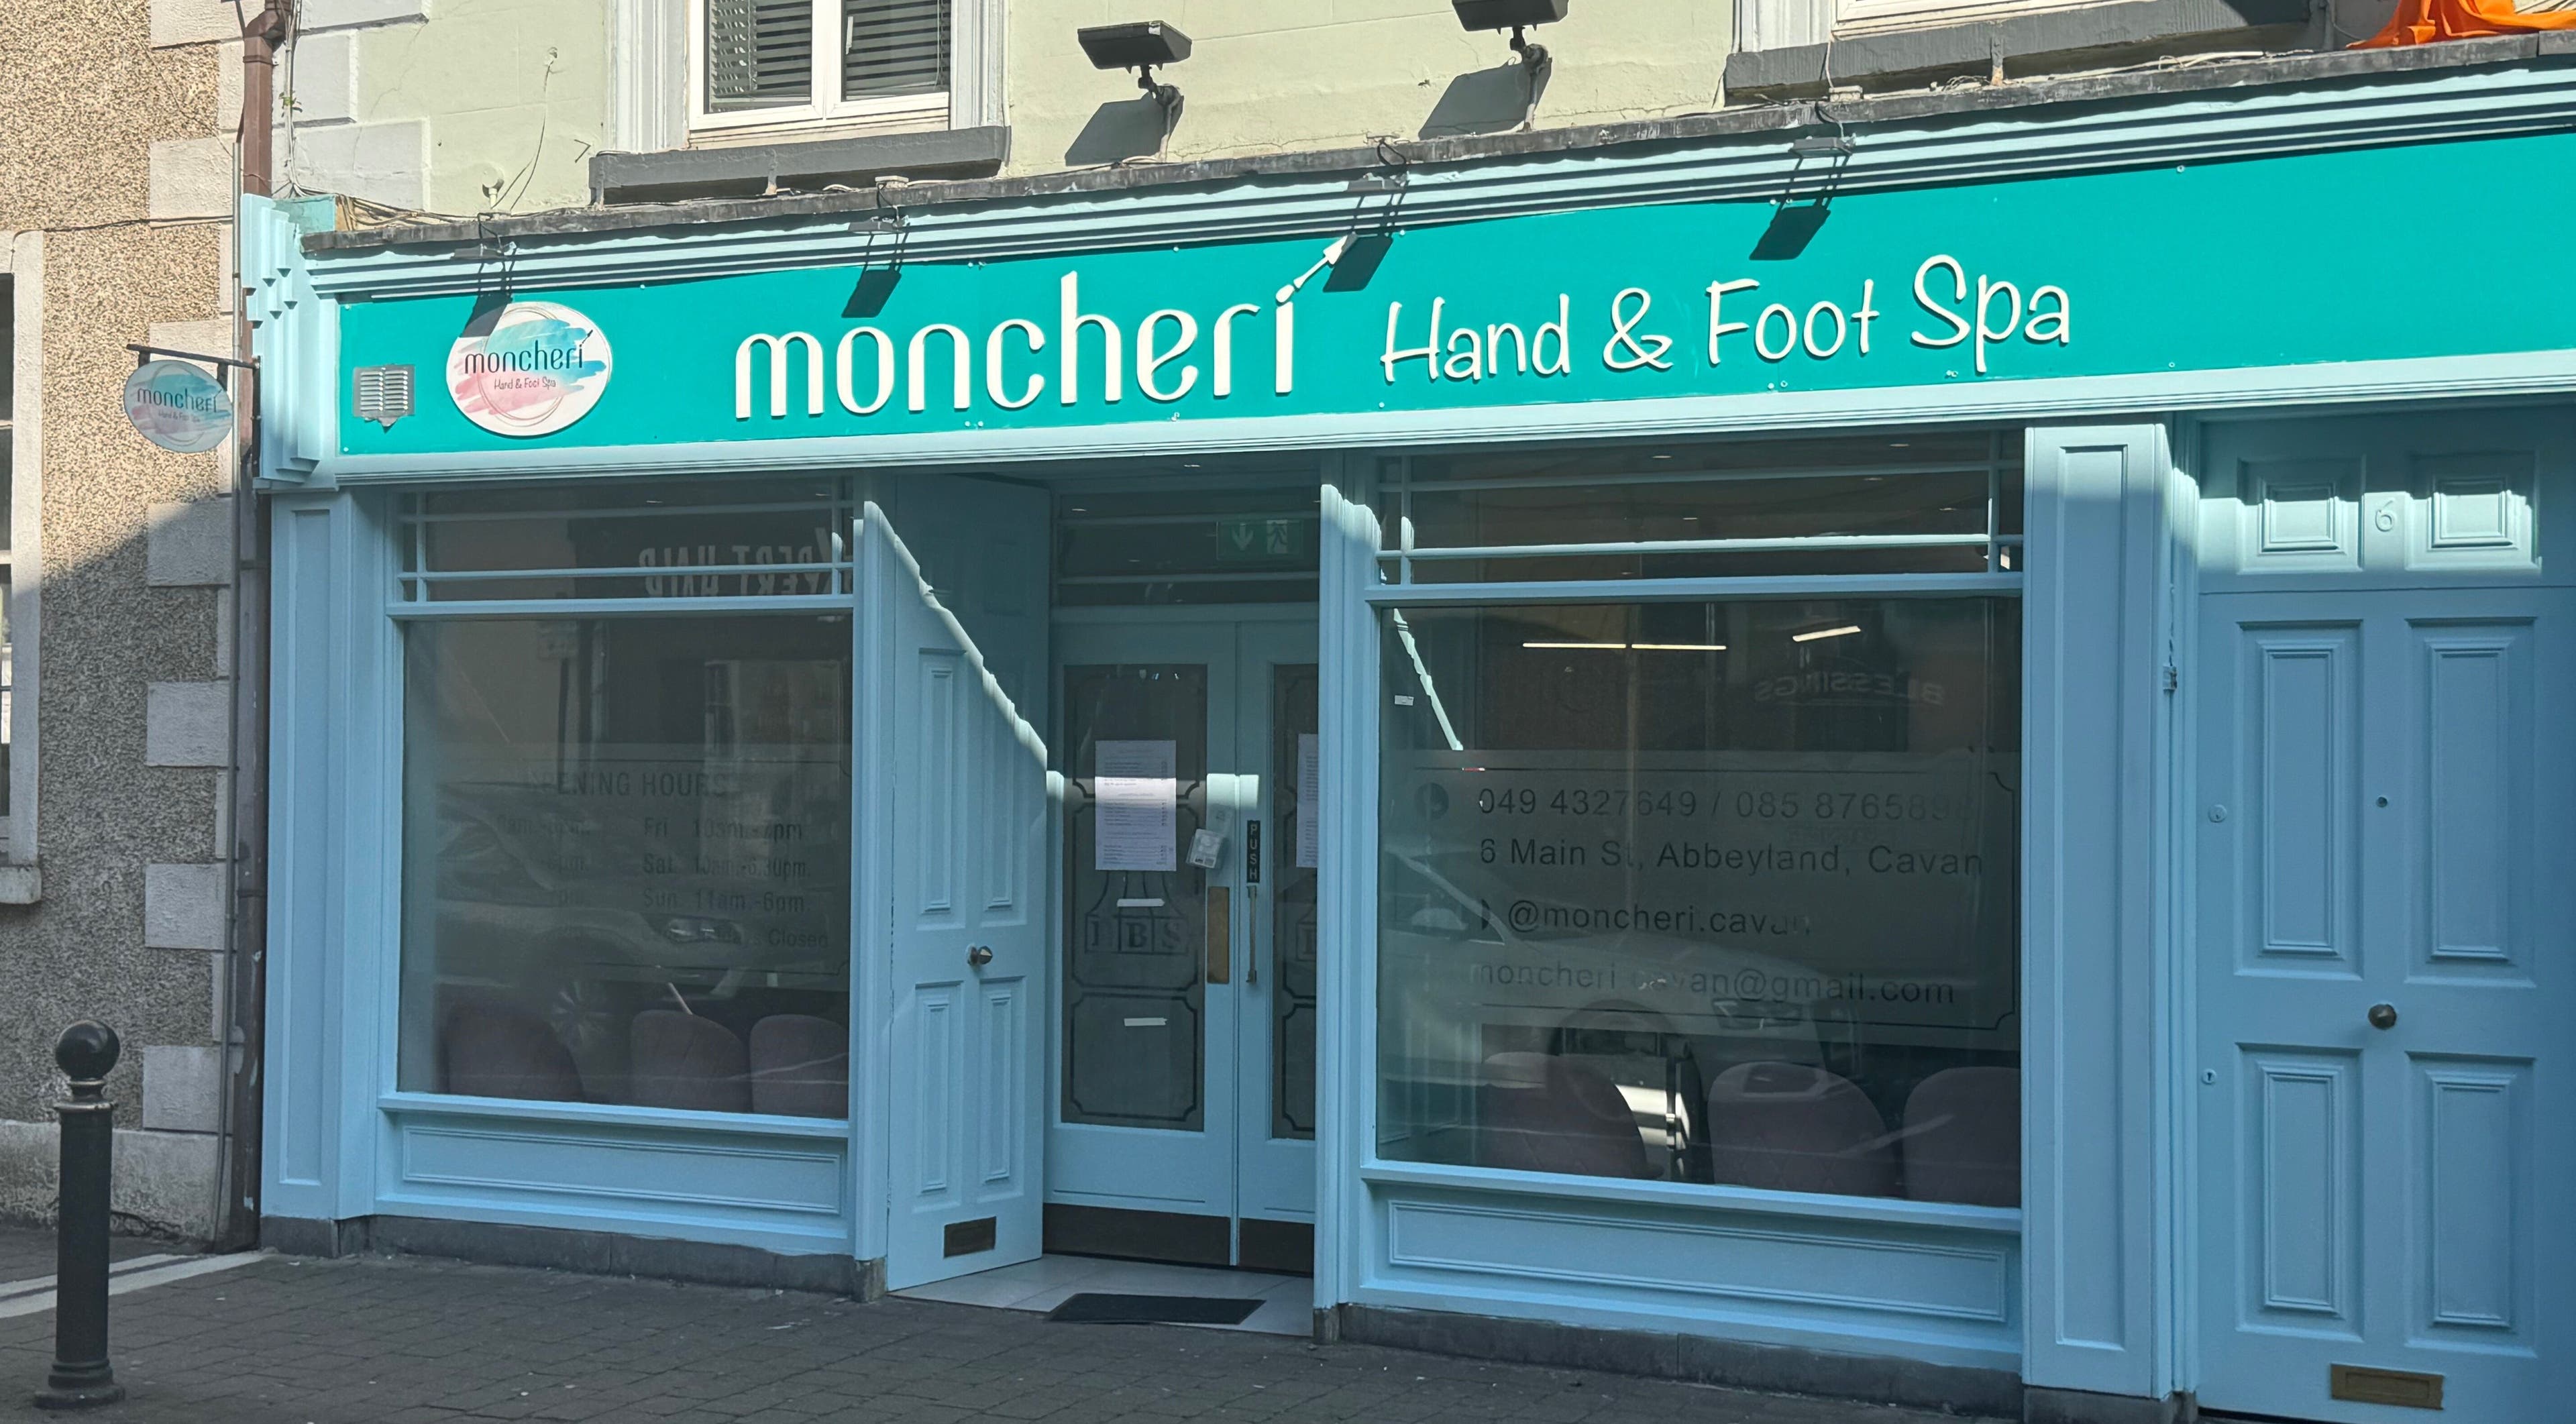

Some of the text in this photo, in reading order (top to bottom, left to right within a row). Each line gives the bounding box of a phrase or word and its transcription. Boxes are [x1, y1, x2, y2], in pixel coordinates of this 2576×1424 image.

[1381, 254, 2070, 384] Hand & Foot Spa
[494, 378, 513, 390] Hand
[515, 378, 522, 388] &
[542, 376, 556, 390] Spa
[2375, 497, 2396, 531] 6
[1478, 788, 1536, 814] 049
[1550, 789, 1697, 816] 4327649
[1736, 791, 1799, 818] 085
[644, 816, 668, 836] Fri
[1250, 824, 1258, 879] PUSH
[1481, 838, 1497, 864] 6
[1511, 838, 1585, 866] Main
[1656, 840, 1851, 877] Abbeyland,
[1868, 844, 1983, 875] Cavan
